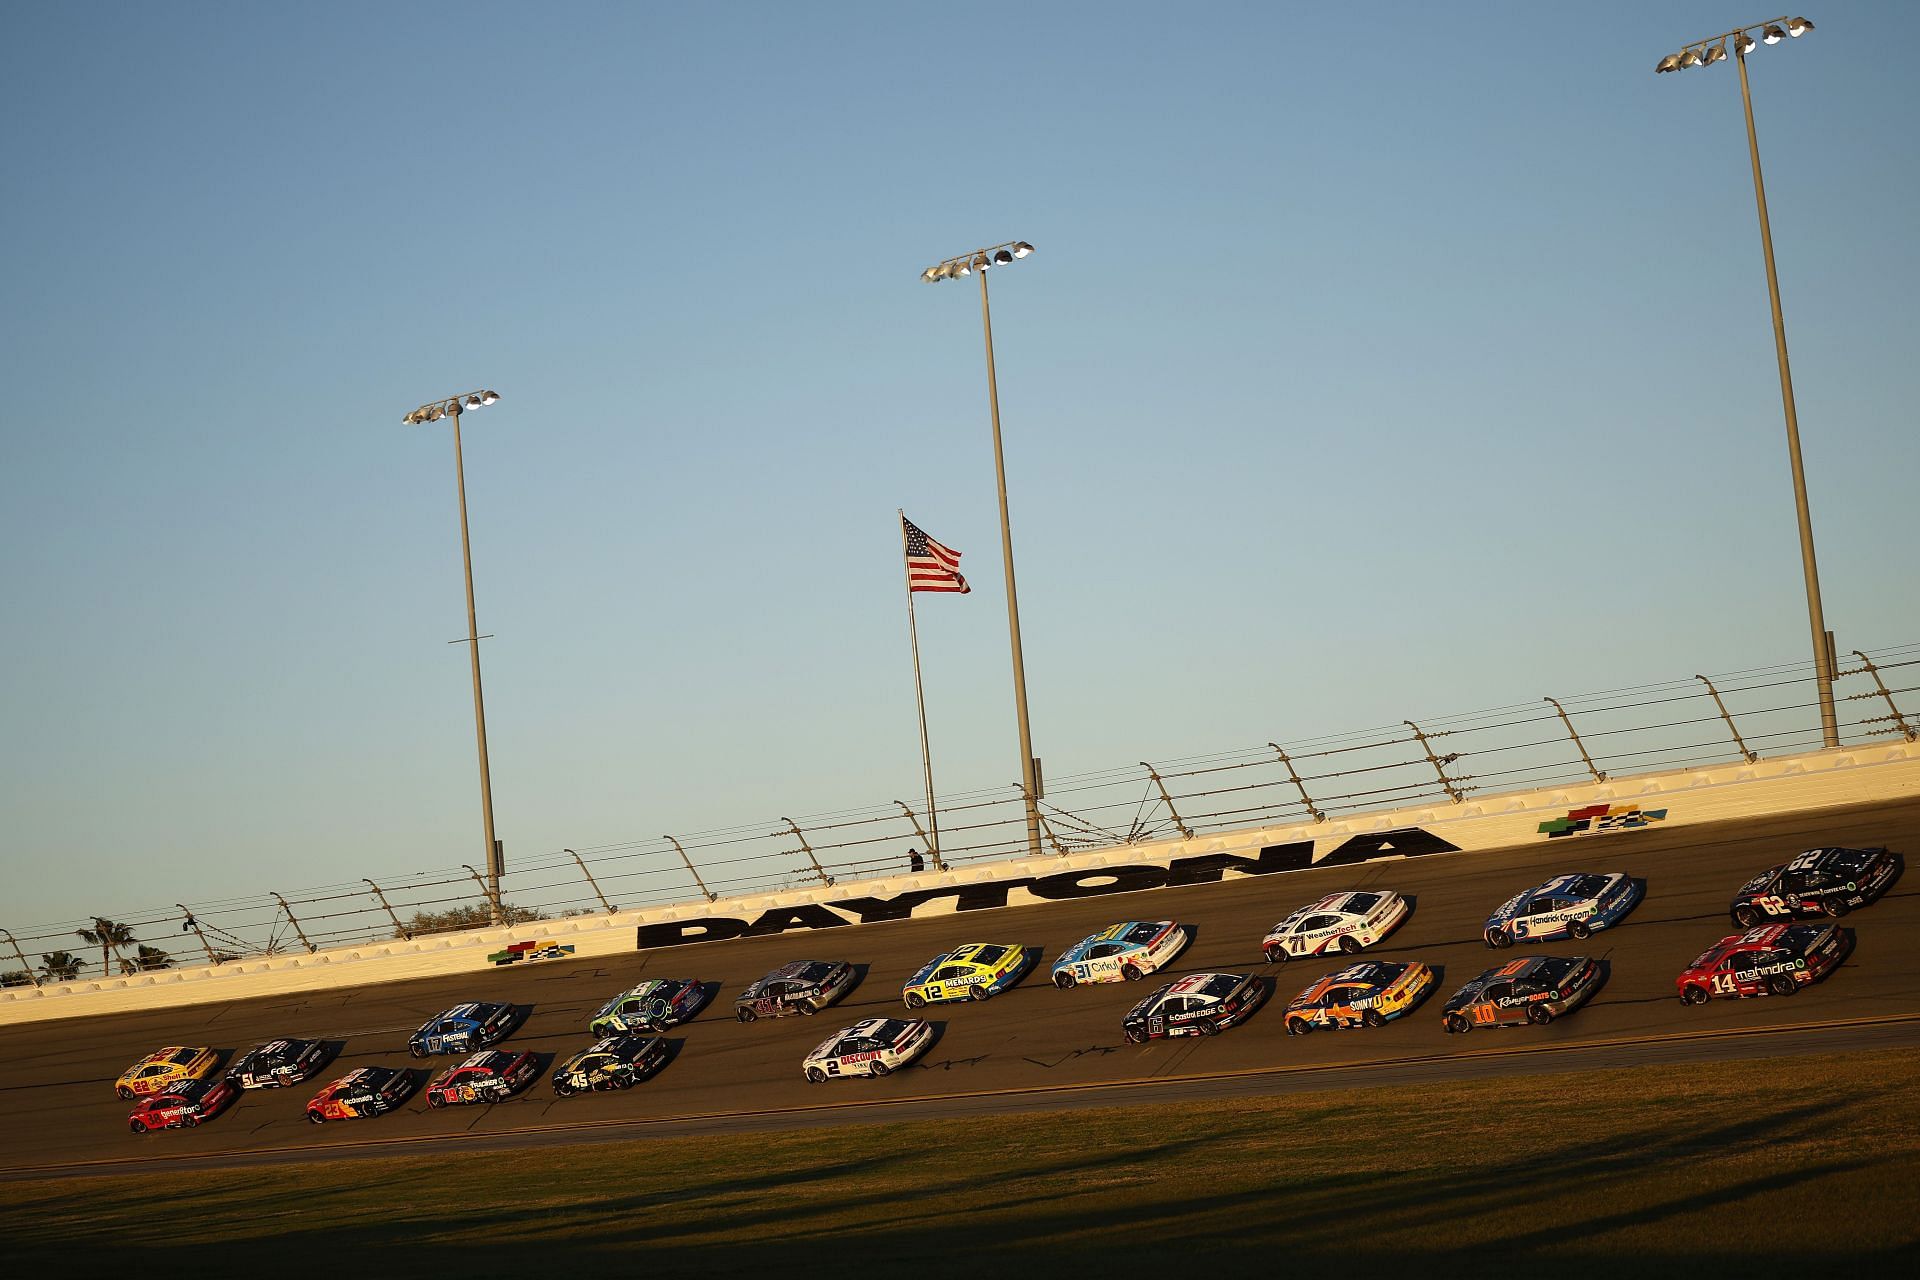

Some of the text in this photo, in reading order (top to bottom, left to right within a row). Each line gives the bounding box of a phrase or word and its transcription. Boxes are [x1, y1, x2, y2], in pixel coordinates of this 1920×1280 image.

[1788, 850, 1823, 871] 62
[637, 827, 1462, 950] DAYTONA
[1759, 895, 1792, 916] 62
[1306, 924, 1358, 940] WeatherTech
[1515, 919, 1529, 939] 5
[1289, 934, 1307, 954] 71
[1075, 963, 1092, 980] 31
[1091, 959, 1119, 973] Cirkul
[1735, 961, 1796, 980] mahindra
[944, 974, 987, 989] MENARDS
[1711, 973, 1738, 995] 14
[923, 985, 943, 1000] 12
[756, 998, 776, 1014] 41
[1196, 1007, 1216, 1018] EDGE
[1472, 1003, 1496, 1025] 10
[610, 1016, 629, 1031] 8
[1313, 1007, 1331, 1026] 4
[1148, 1016, 1164, 1035] 6
[426, 1036, 443, 1053] 17
[442, 1031, 469, 1043] FASTENAL
[840, 1049, 882, 1065] DISCOUNT
[826, 1060, 841, 1076] 2
[162, 1072, 182, 1081] Shell
[242, 1073, 254, 1087] 51
[571, 1073, 588, 1088] 45
[132, 1080, 150, 1093] 22
[343, 1094, 374, 1106] McDonald's
[442, 1087, 458, 1103] 19
[324, 1103, 341, 1117] 23
[147, 1113, 163, 1125] 38
